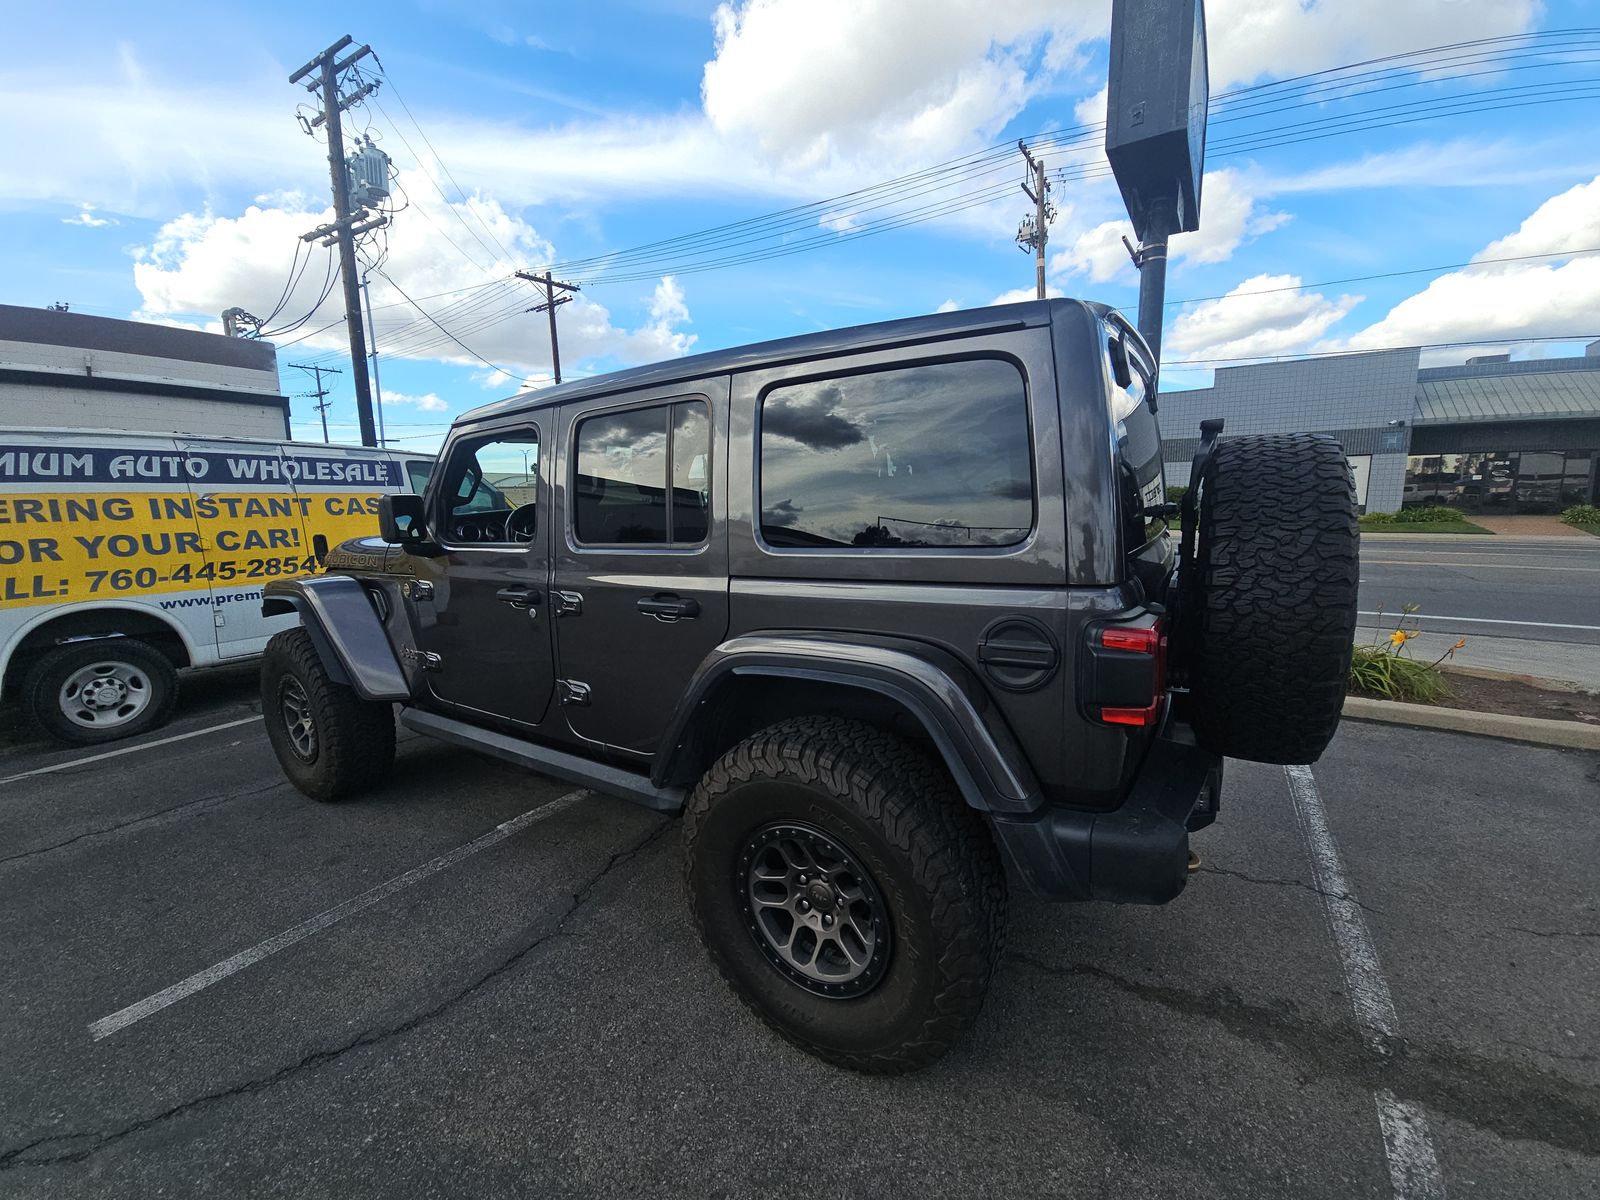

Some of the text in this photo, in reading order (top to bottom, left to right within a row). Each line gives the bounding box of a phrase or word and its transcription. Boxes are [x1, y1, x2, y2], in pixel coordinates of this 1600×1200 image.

[109, 455, 209, 479] AUTO
[226, 458, 389, 482] WHOLESALE
[149, 497, 312, 519] INSTANT
[0, 527, 300, 565] OR YOUR CAR!
[325, 553, 378, 568] RUBICON
[0, 555, 317, 600] LL: 760-445-2854
